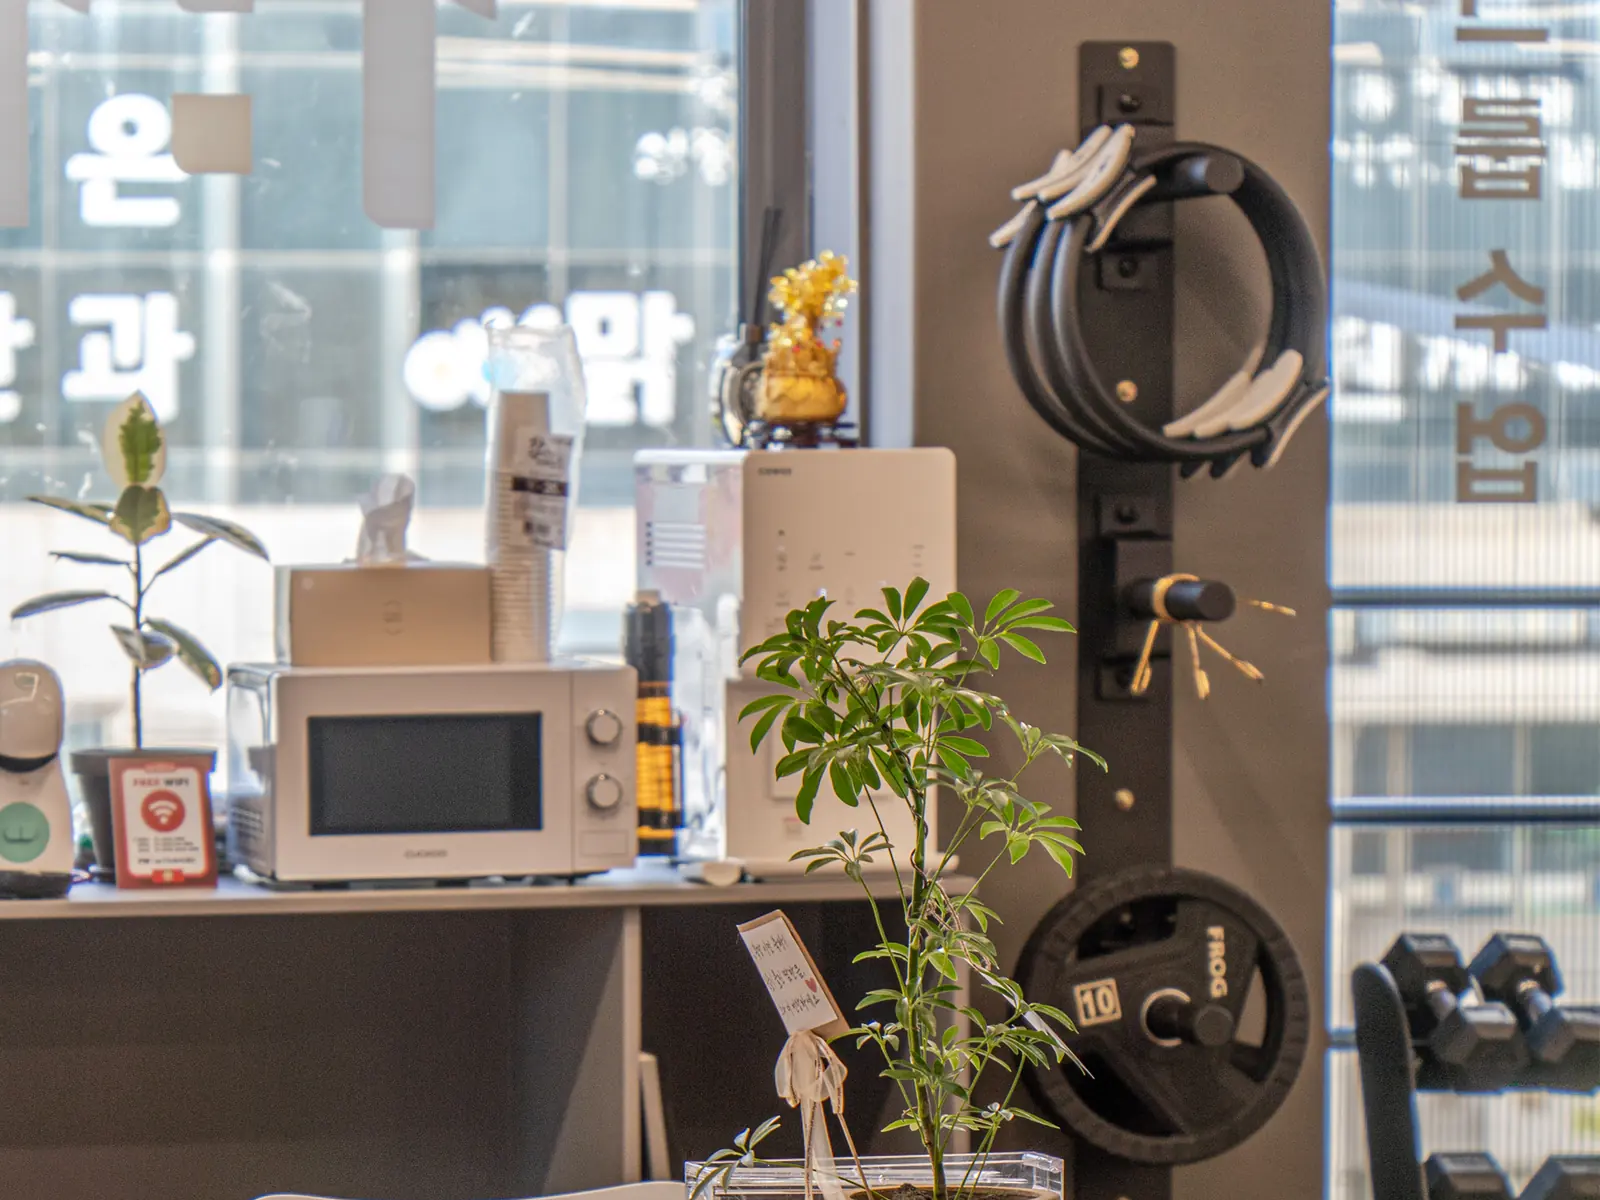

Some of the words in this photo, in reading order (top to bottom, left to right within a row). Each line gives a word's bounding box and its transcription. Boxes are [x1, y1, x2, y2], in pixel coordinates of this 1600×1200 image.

[65, 93, 190, 227] 은
[1206, 925, 1229, 999] FROG
[1080, 985, 1113, 1019] 10
